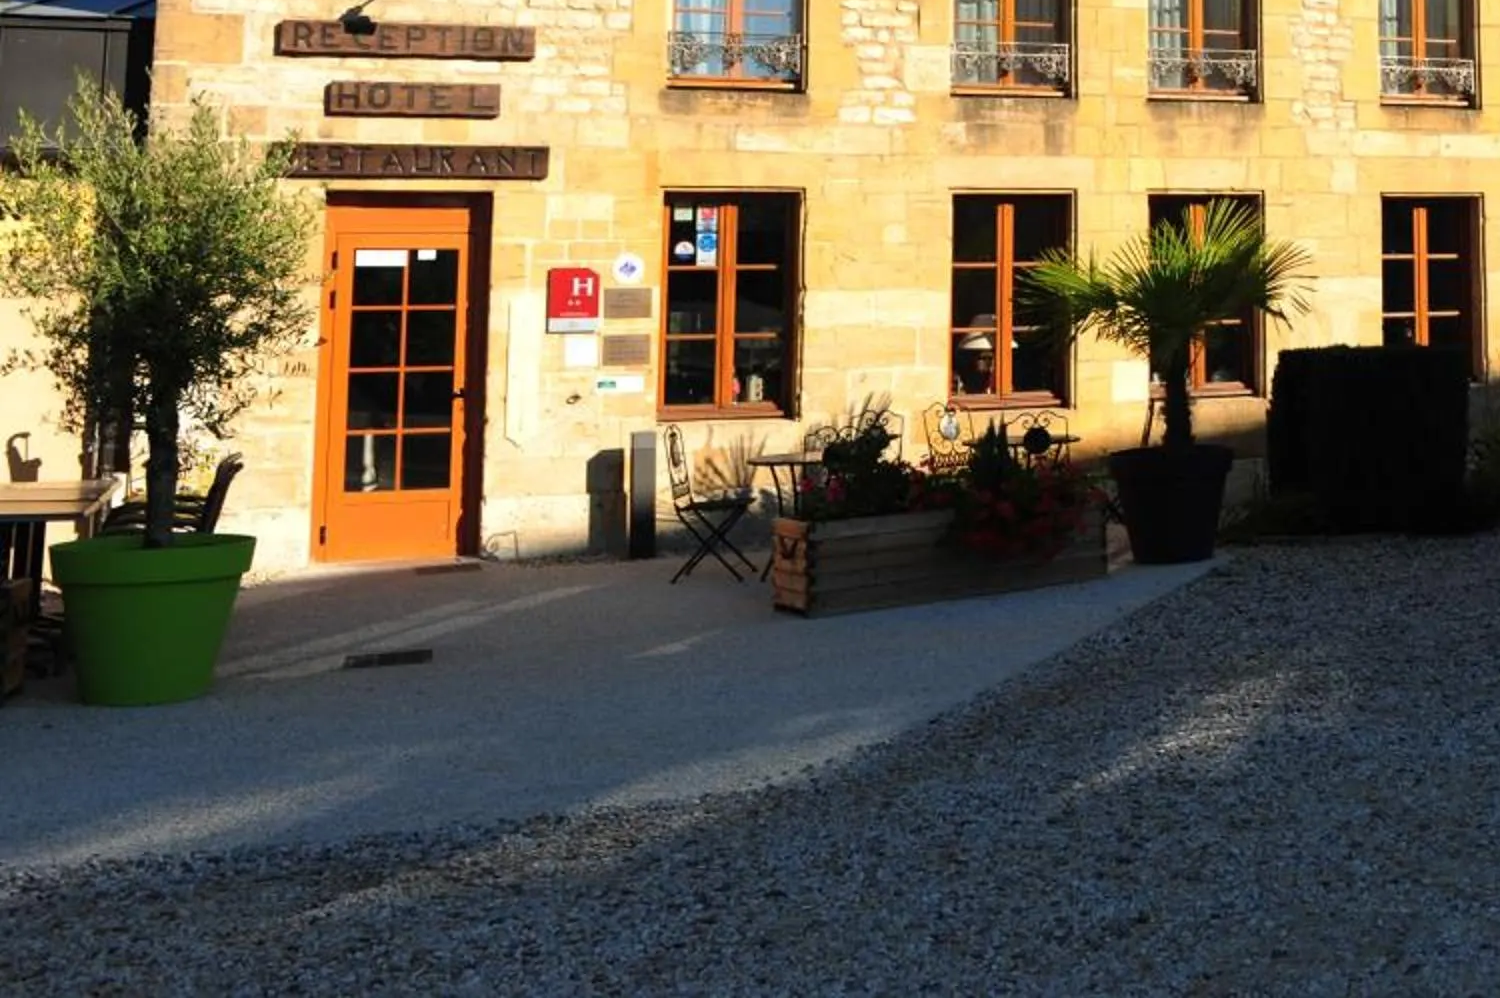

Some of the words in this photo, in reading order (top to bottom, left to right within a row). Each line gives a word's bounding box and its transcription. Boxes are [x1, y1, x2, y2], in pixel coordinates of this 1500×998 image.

[336, 82, 495, 110] HOTEL
[282, 143, 544, 175] ESTAURANT
[572, 277, 594, 296] H
